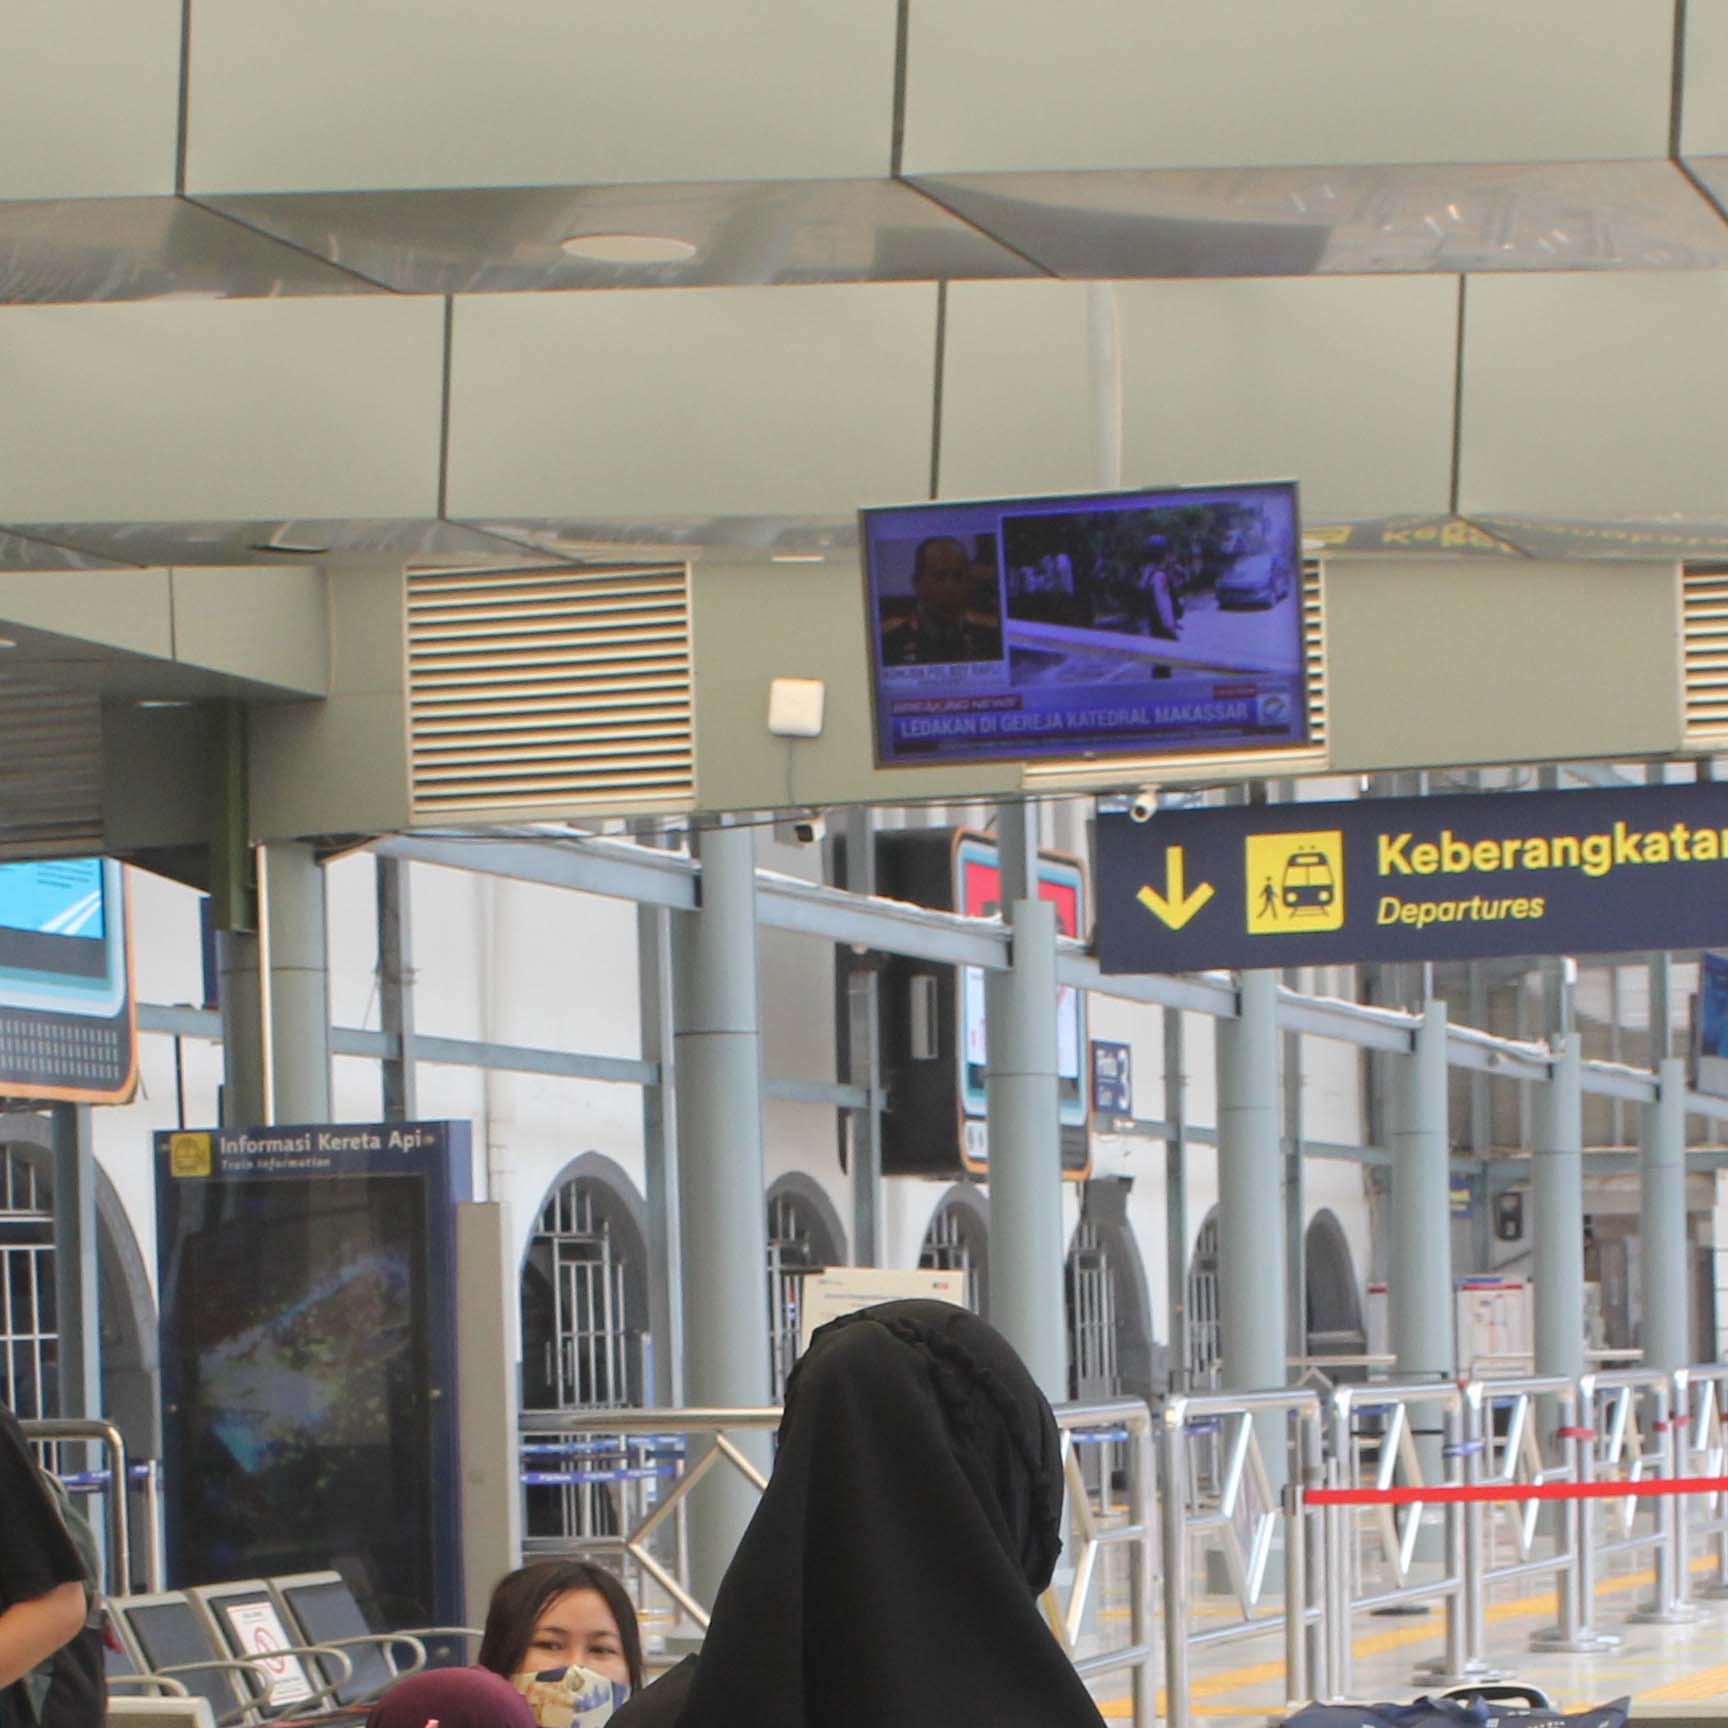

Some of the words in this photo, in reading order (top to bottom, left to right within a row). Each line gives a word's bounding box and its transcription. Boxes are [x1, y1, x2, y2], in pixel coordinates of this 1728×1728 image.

[901, 719, 975, 738] LEDAKAN
[980, 717, 997, 735] DI
[1003, 712, 1062, 733] GEREJA
[1066, 708, 1149, 730] KATEDRAL
[1155, 702, 1248, 726] MAKASSAR
[1377, 896, 1545, 928] Departures
[220, 1133, 312, 1155] Informasi
[318, 1131, 381, 1152] Kereta
[388, 1129, 422, 1153] Api
